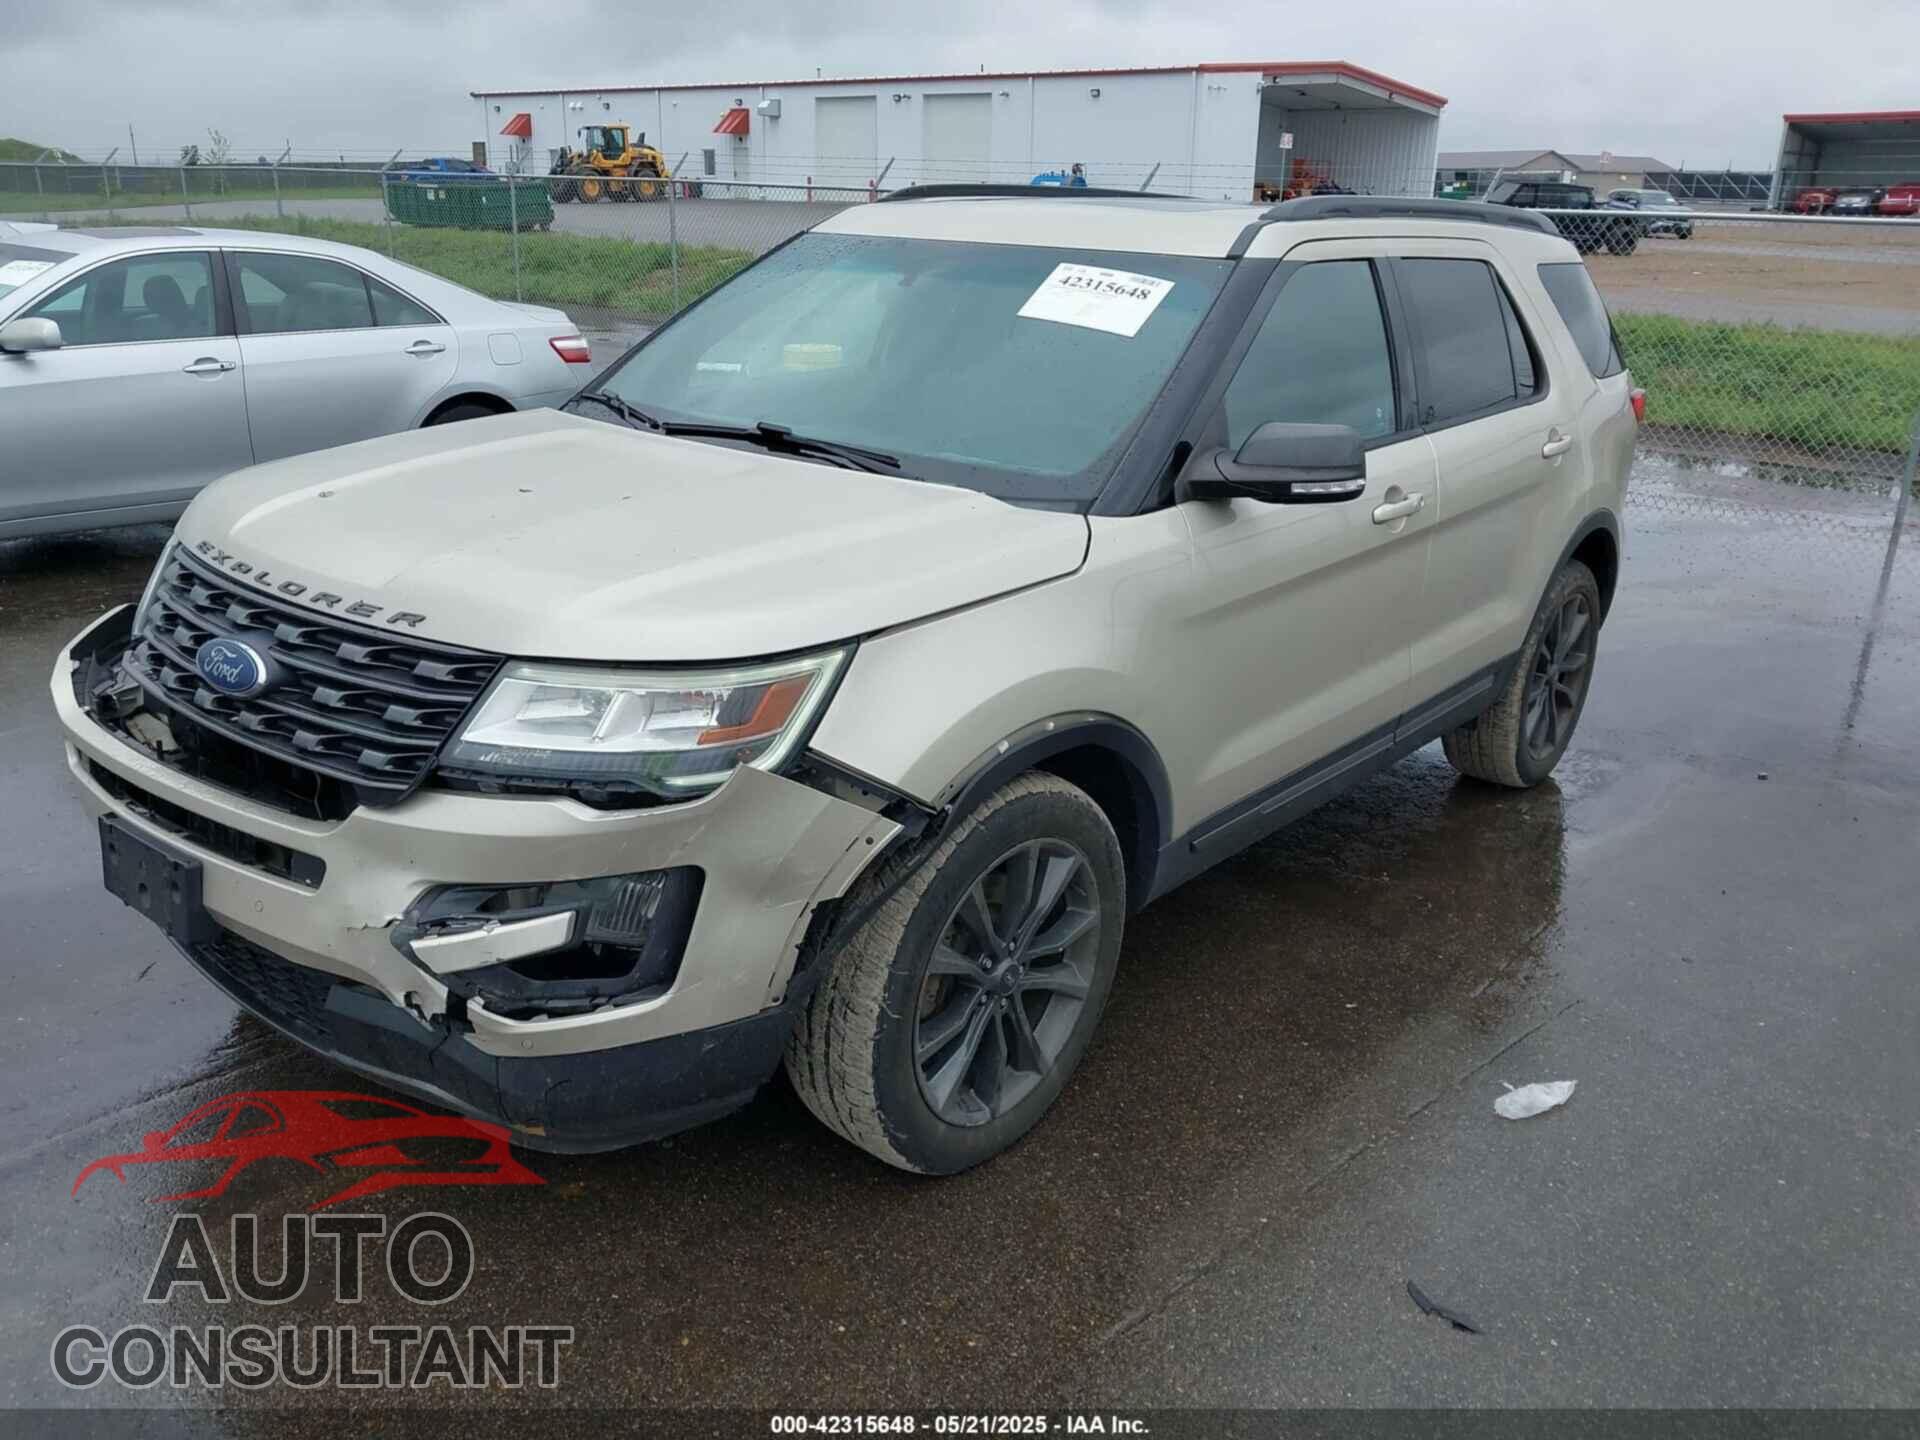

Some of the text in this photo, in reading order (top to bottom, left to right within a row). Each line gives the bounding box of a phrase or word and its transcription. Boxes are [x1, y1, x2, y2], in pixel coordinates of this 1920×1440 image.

[1058, 275, 1152, 301] 42315648
[196, 540, 427, 628] EXPLORER
[203, 645, 244, 684] Ford
